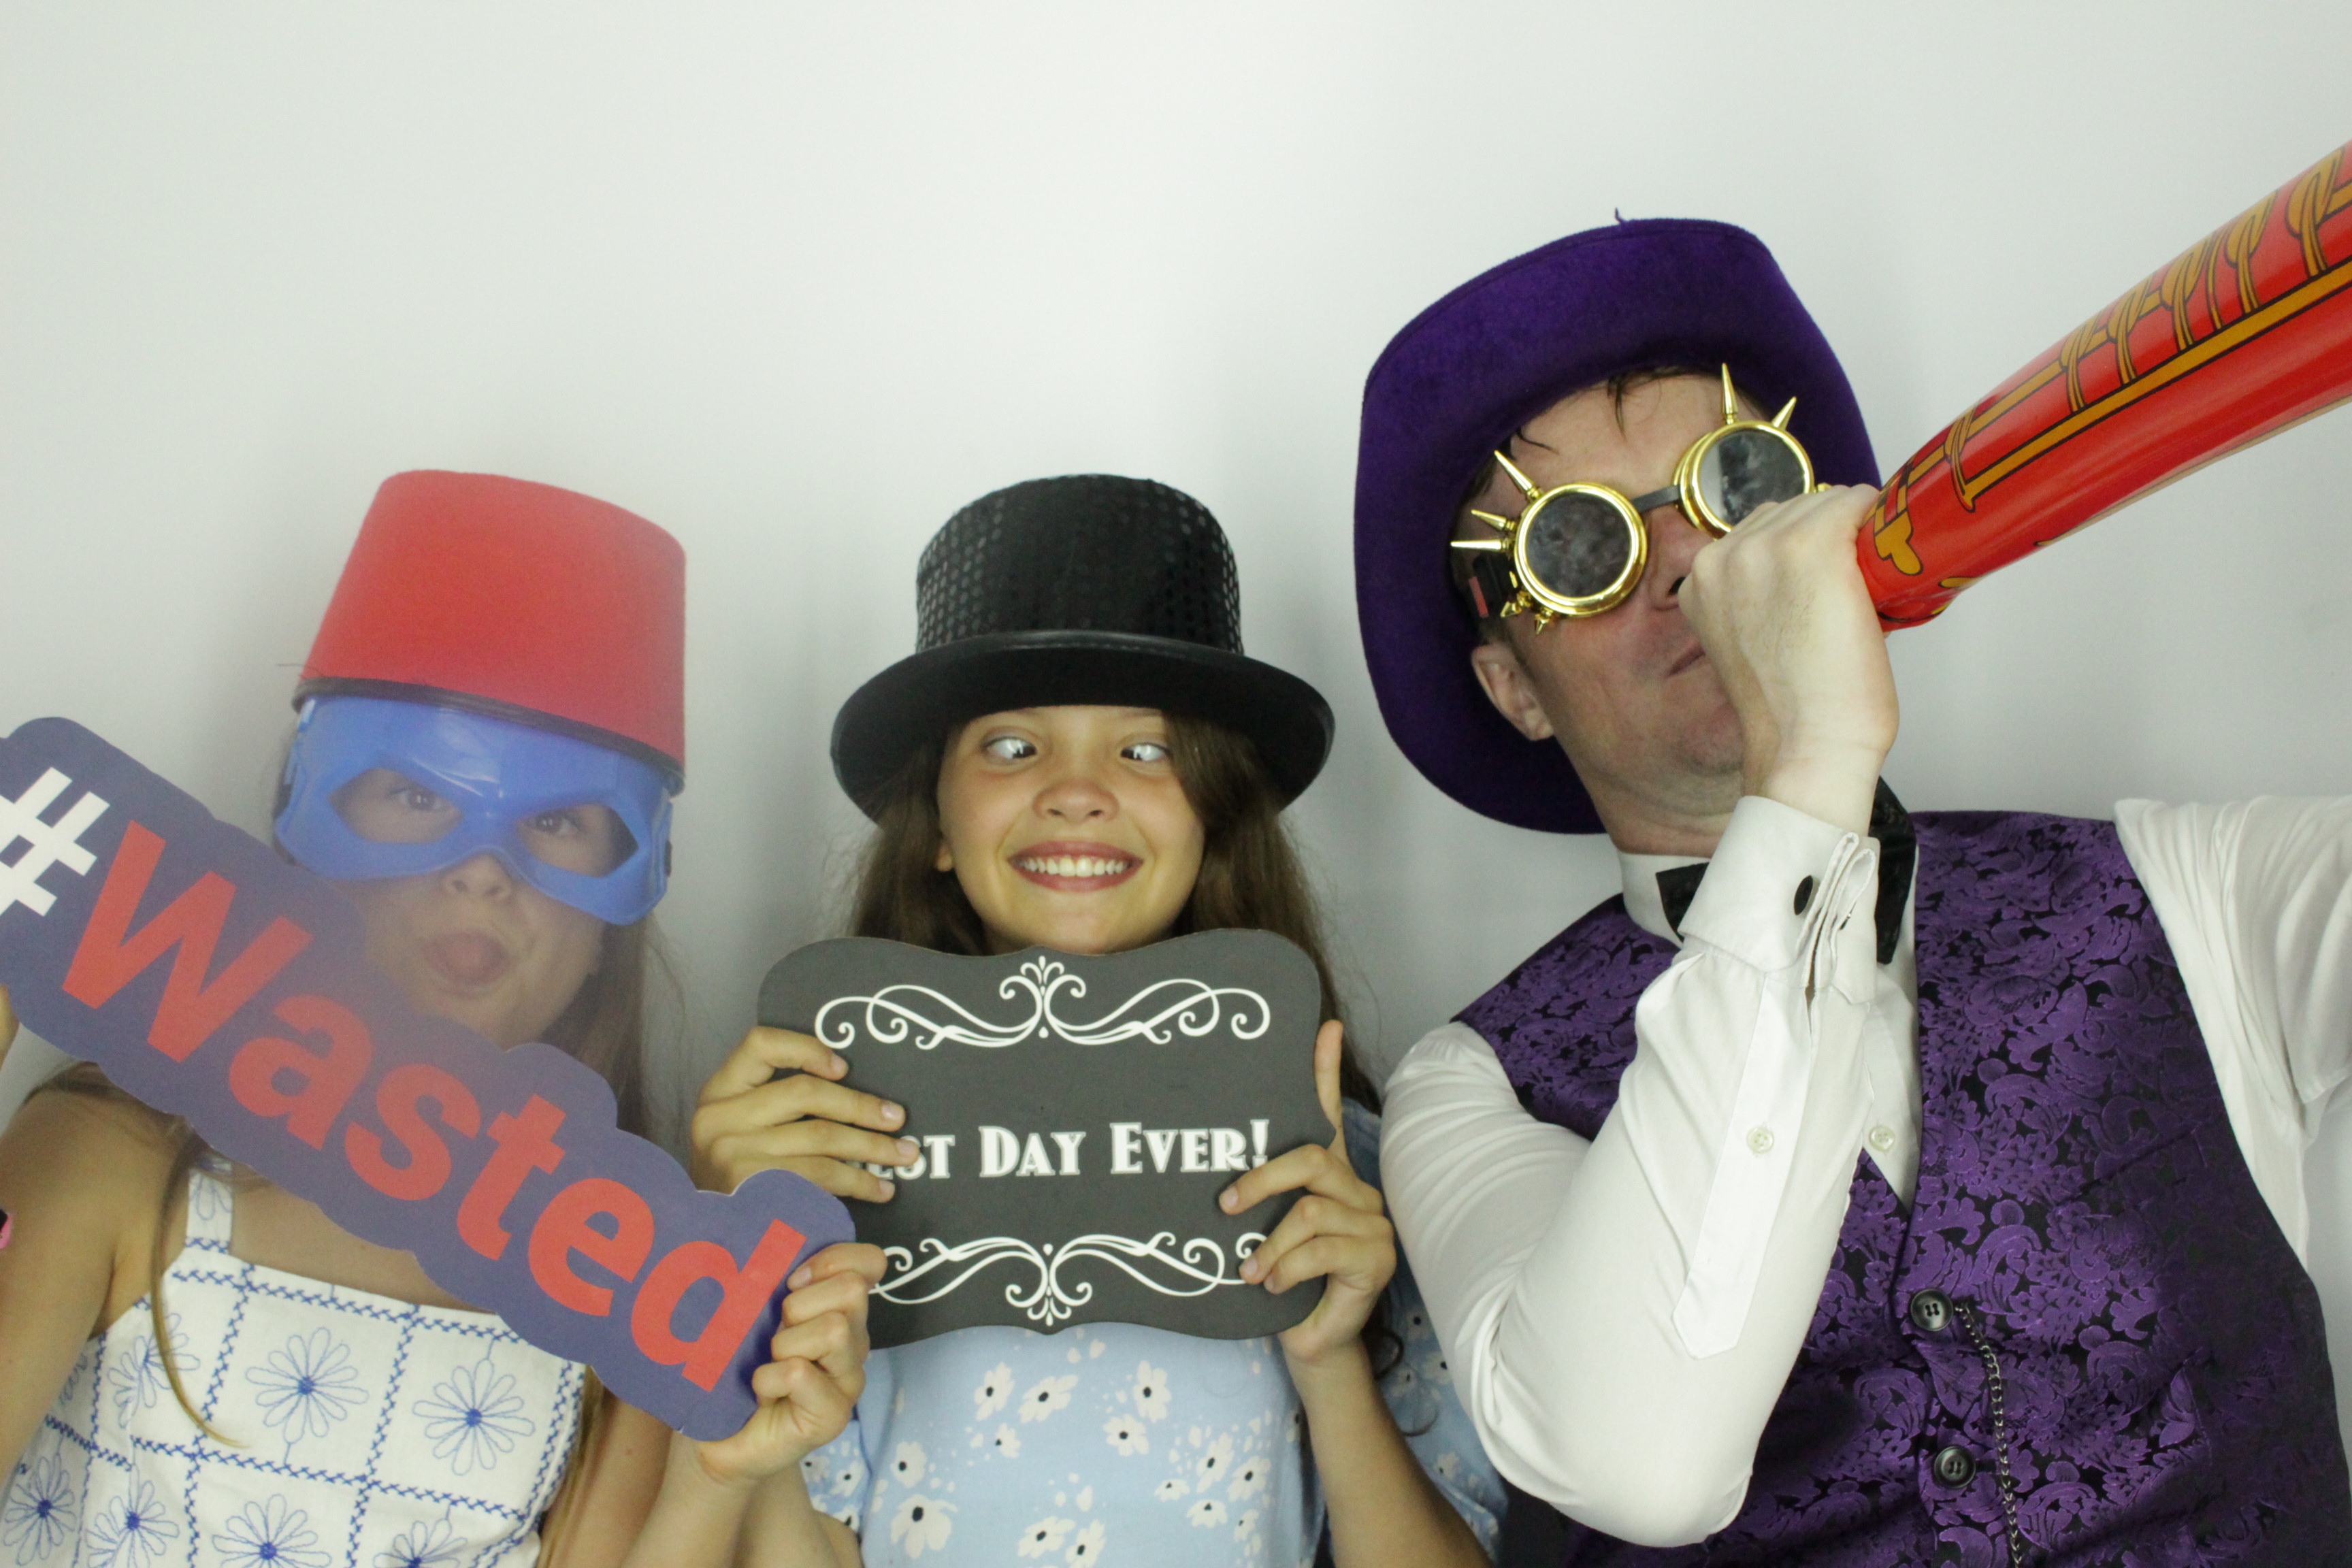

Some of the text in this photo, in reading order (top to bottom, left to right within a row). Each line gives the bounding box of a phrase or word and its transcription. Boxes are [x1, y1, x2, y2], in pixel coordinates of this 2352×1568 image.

[0, 767, 807, 1392] #Wasted
[979, 1125, 1086, 1178] DAY
[1109, 1119, 1269, 1175] EVER!
